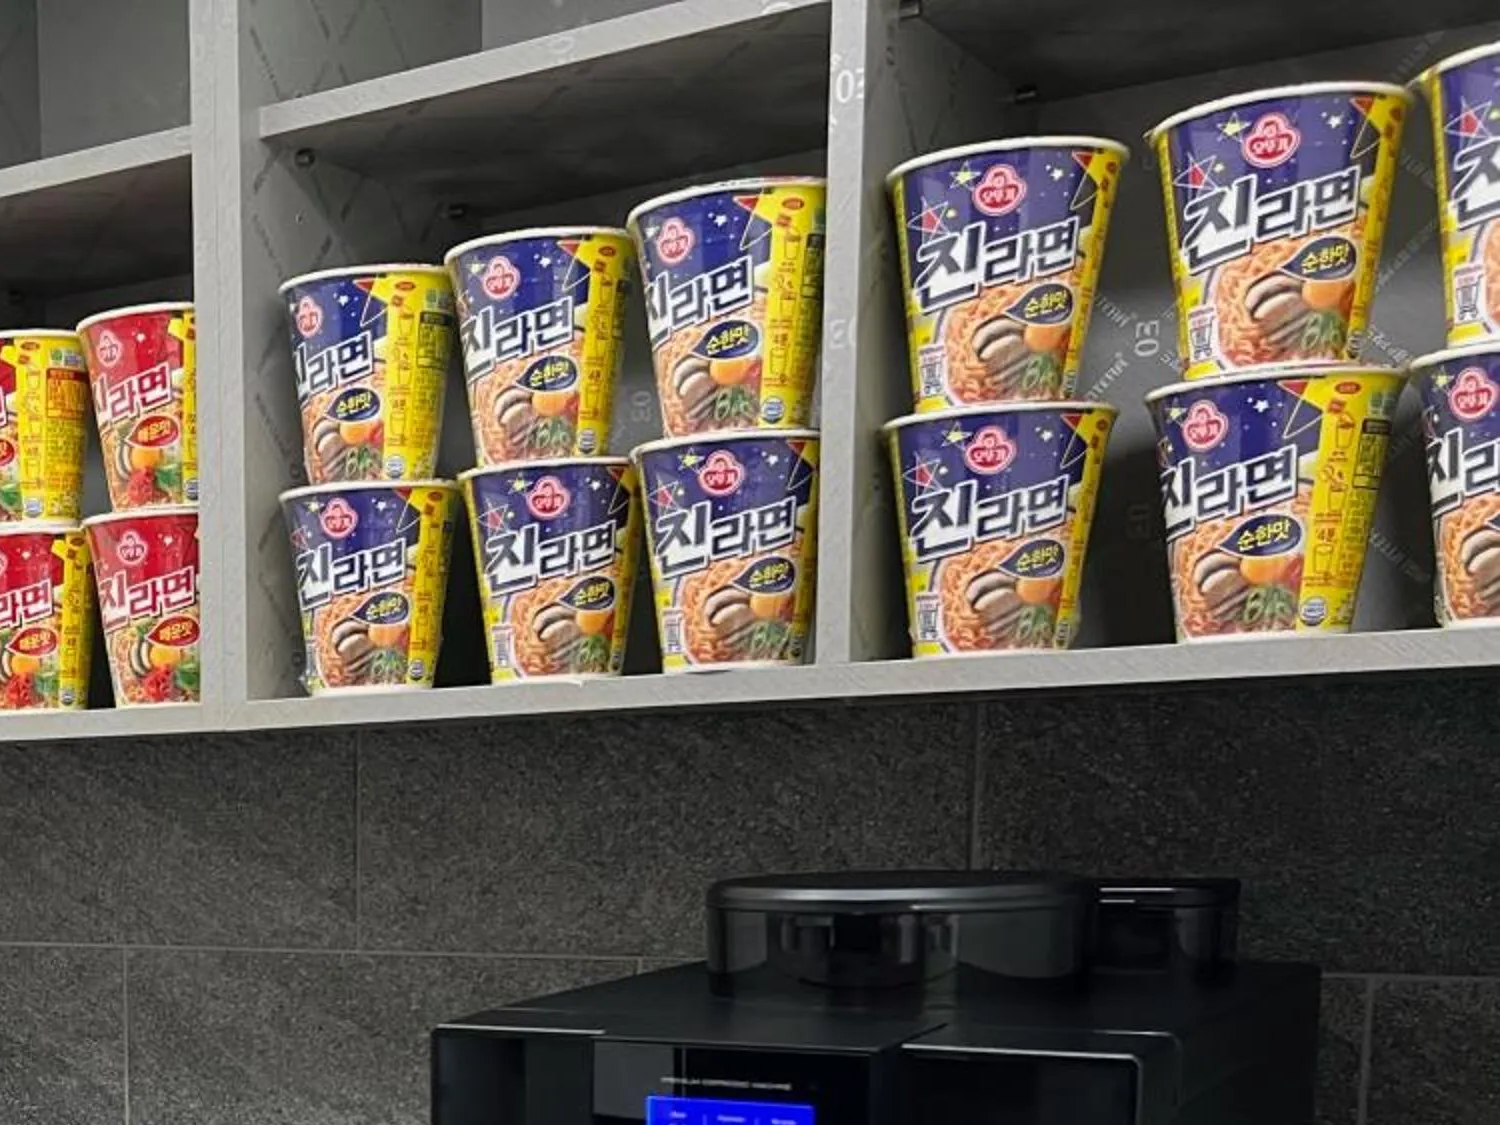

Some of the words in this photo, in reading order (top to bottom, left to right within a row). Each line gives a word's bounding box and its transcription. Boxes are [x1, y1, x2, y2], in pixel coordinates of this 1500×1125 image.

[1181, 165, 1362, 277] 진라면
[1301, 242, 1350, 274] 순한맛
[914, 215, 1081, 316] 진라면
[460, 296, 574, 384] 진라면
[706, 325, 750, 356] 순한맛
[910, 474, 1070, 565] 진라면
[1160, 443, 1299, 544] 진라면
[296, 537, 406, 611] 진라면
[485, 519, 617, 598] 진라면
[656, 496, 797, 579] 진라면
[1237, 518, 1293, 551] 순한맛
[100, 566, 194, 632] 진라면
